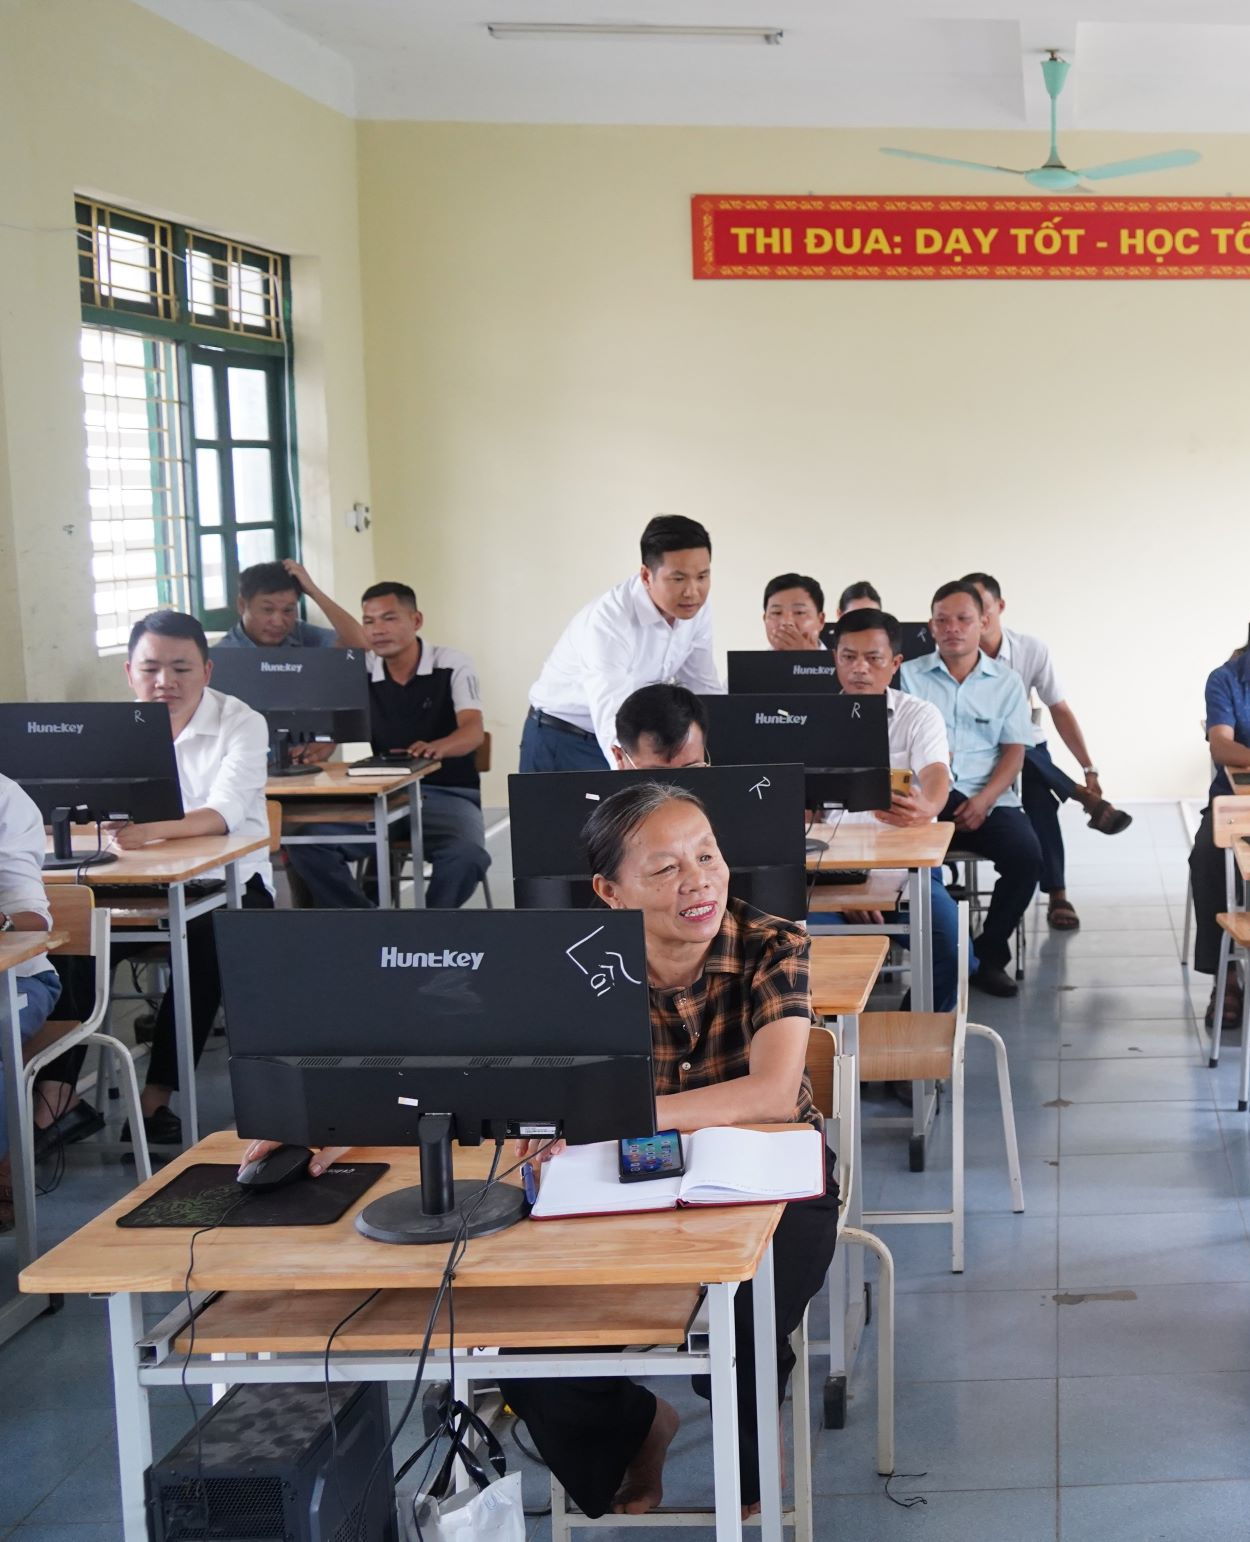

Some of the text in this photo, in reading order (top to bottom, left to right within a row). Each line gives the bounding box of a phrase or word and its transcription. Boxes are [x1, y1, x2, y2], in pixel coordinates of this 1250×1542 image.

[730, 228, 792, 254] THI
[804, 228, 902, 254] ĐUA:
[916, 228, 998, 262] DẠY
[1010, 216, 1085, 255] TỐT
[1120, 228, 1200, 263] HỌC
